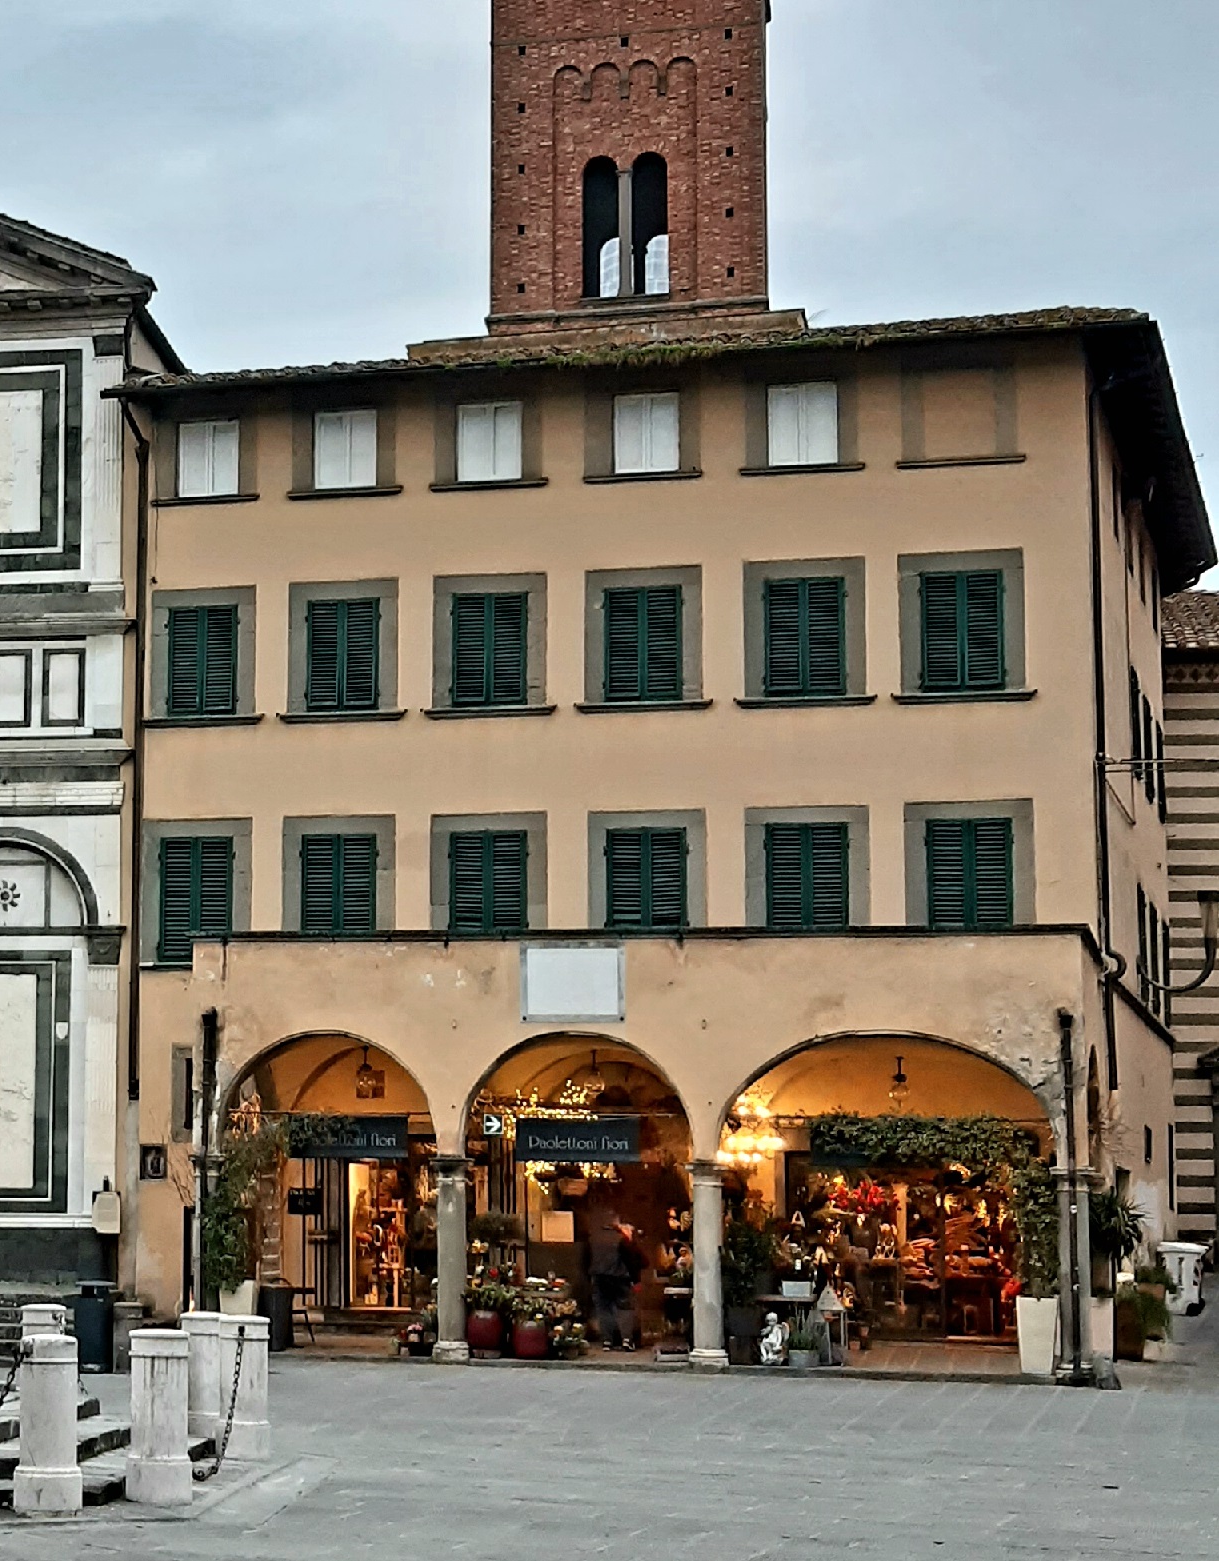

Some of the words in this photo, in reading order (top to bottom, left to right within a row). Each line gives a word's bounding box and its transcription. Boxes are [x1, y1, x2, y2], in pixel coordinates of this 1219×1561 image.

[370, 1133, 397, 1147] fiori
[528, 1135, 597, 1150] Paolettoni
[602, 1135, 629, 1150] fiori
